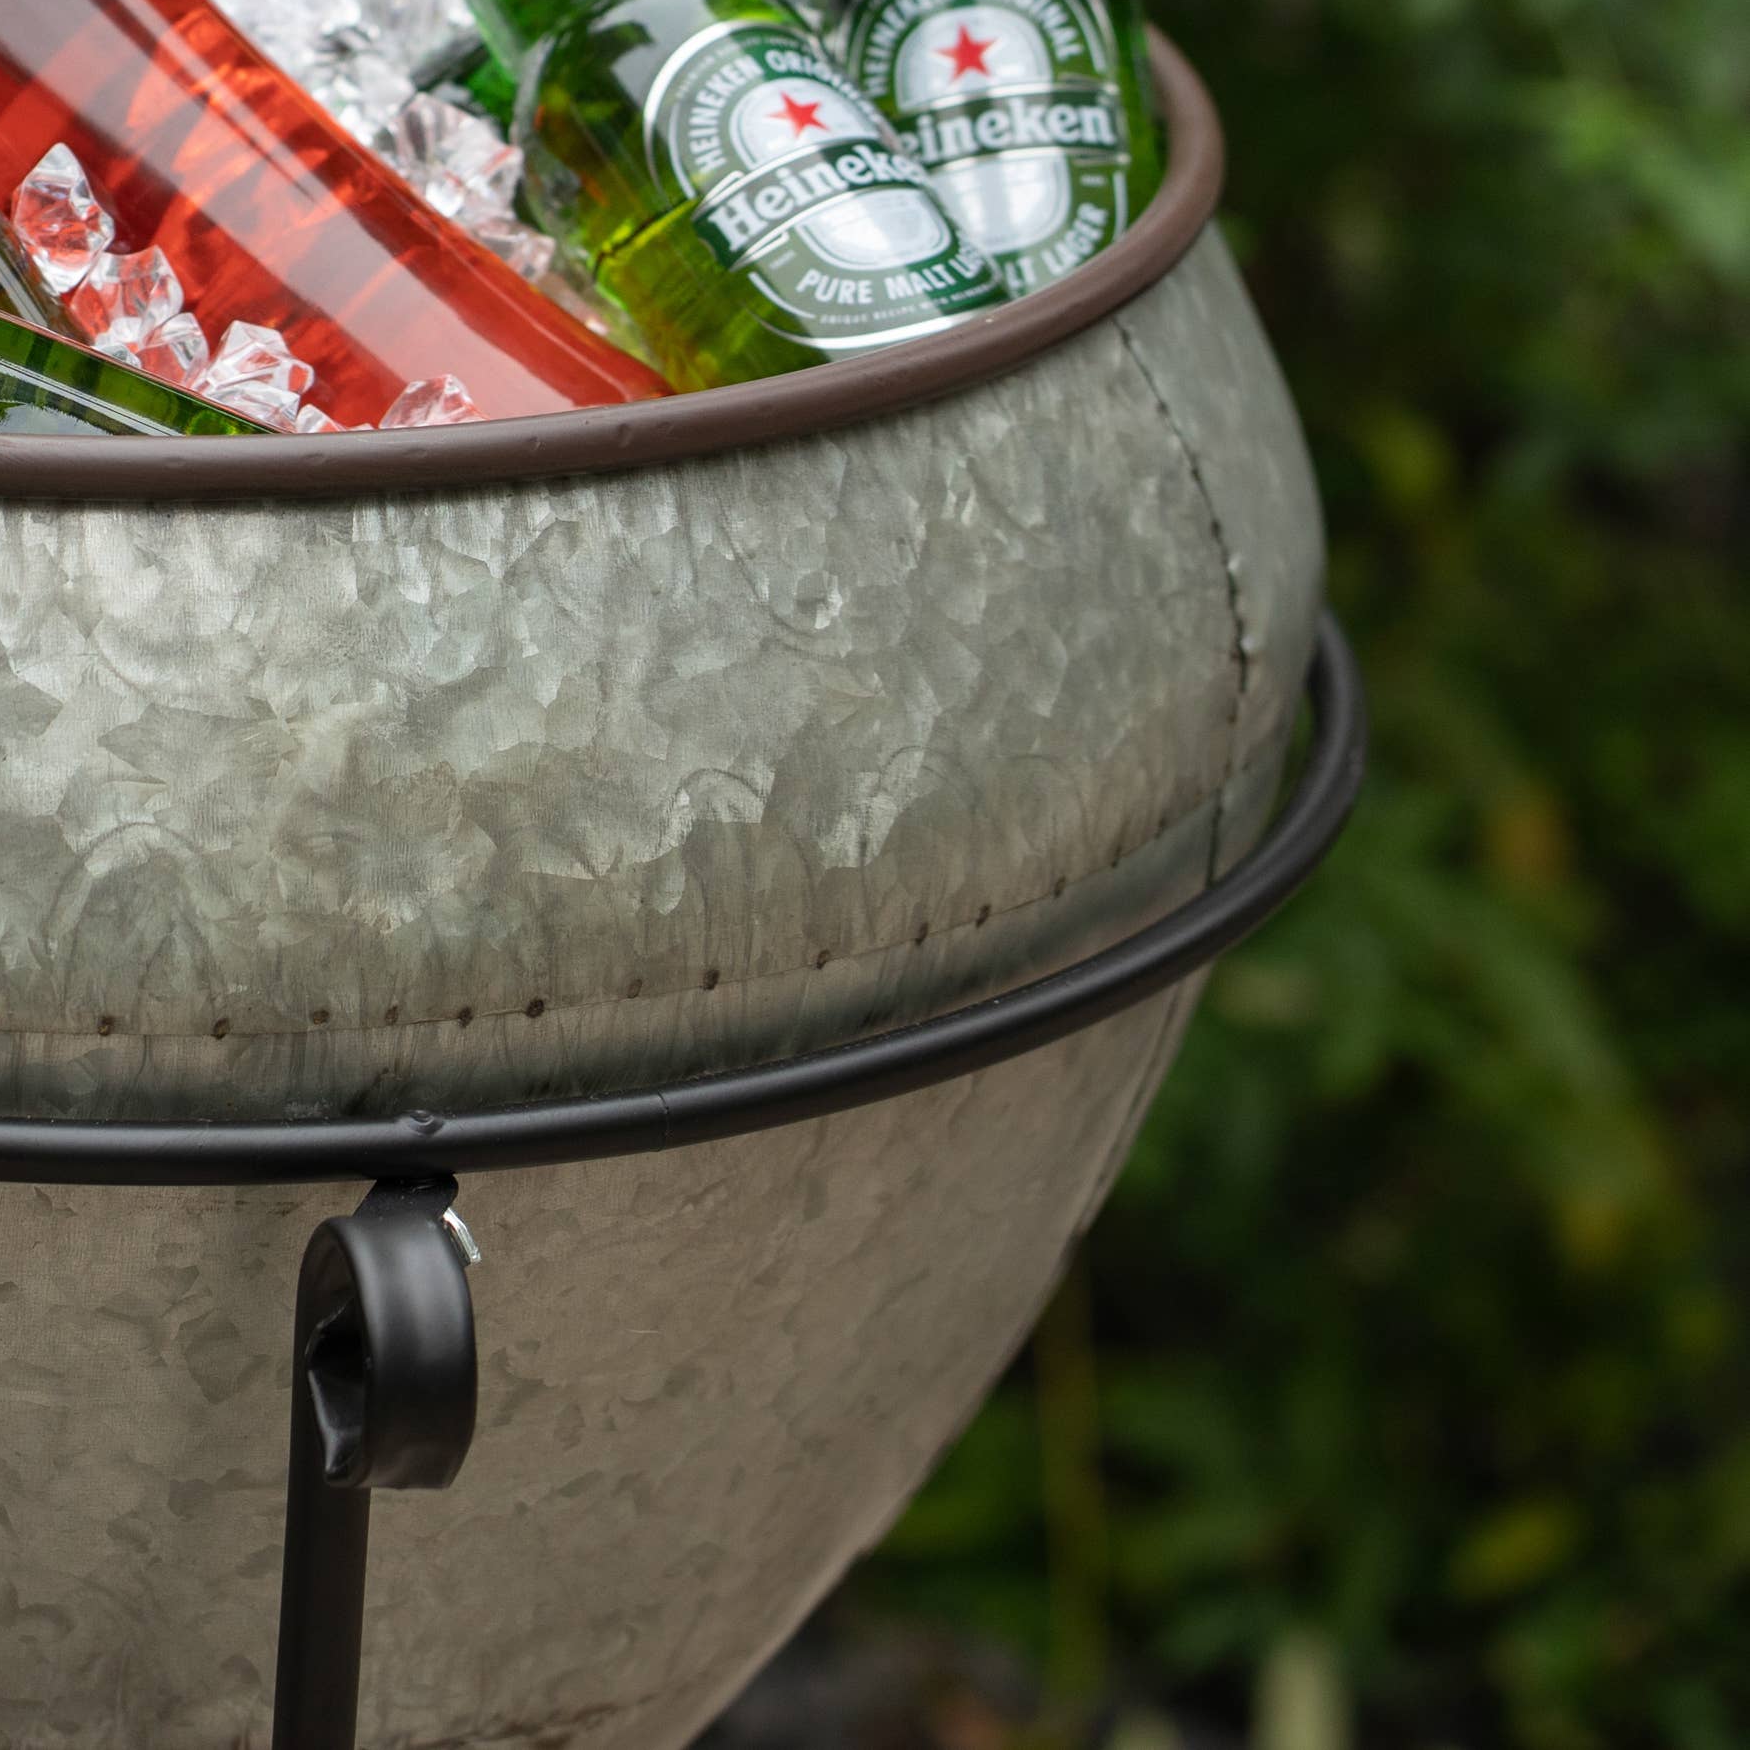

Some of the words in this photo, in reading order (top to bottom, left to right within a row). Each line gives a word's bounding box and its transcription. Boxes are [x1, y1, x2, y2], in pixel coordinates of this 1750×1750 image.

[687, 54, 765, 173] HEINEKEN
[898, 96, 1116, 164] eineken
[795, 268, 873, 305] PURE
[883, 262, 958, 301] MALT
